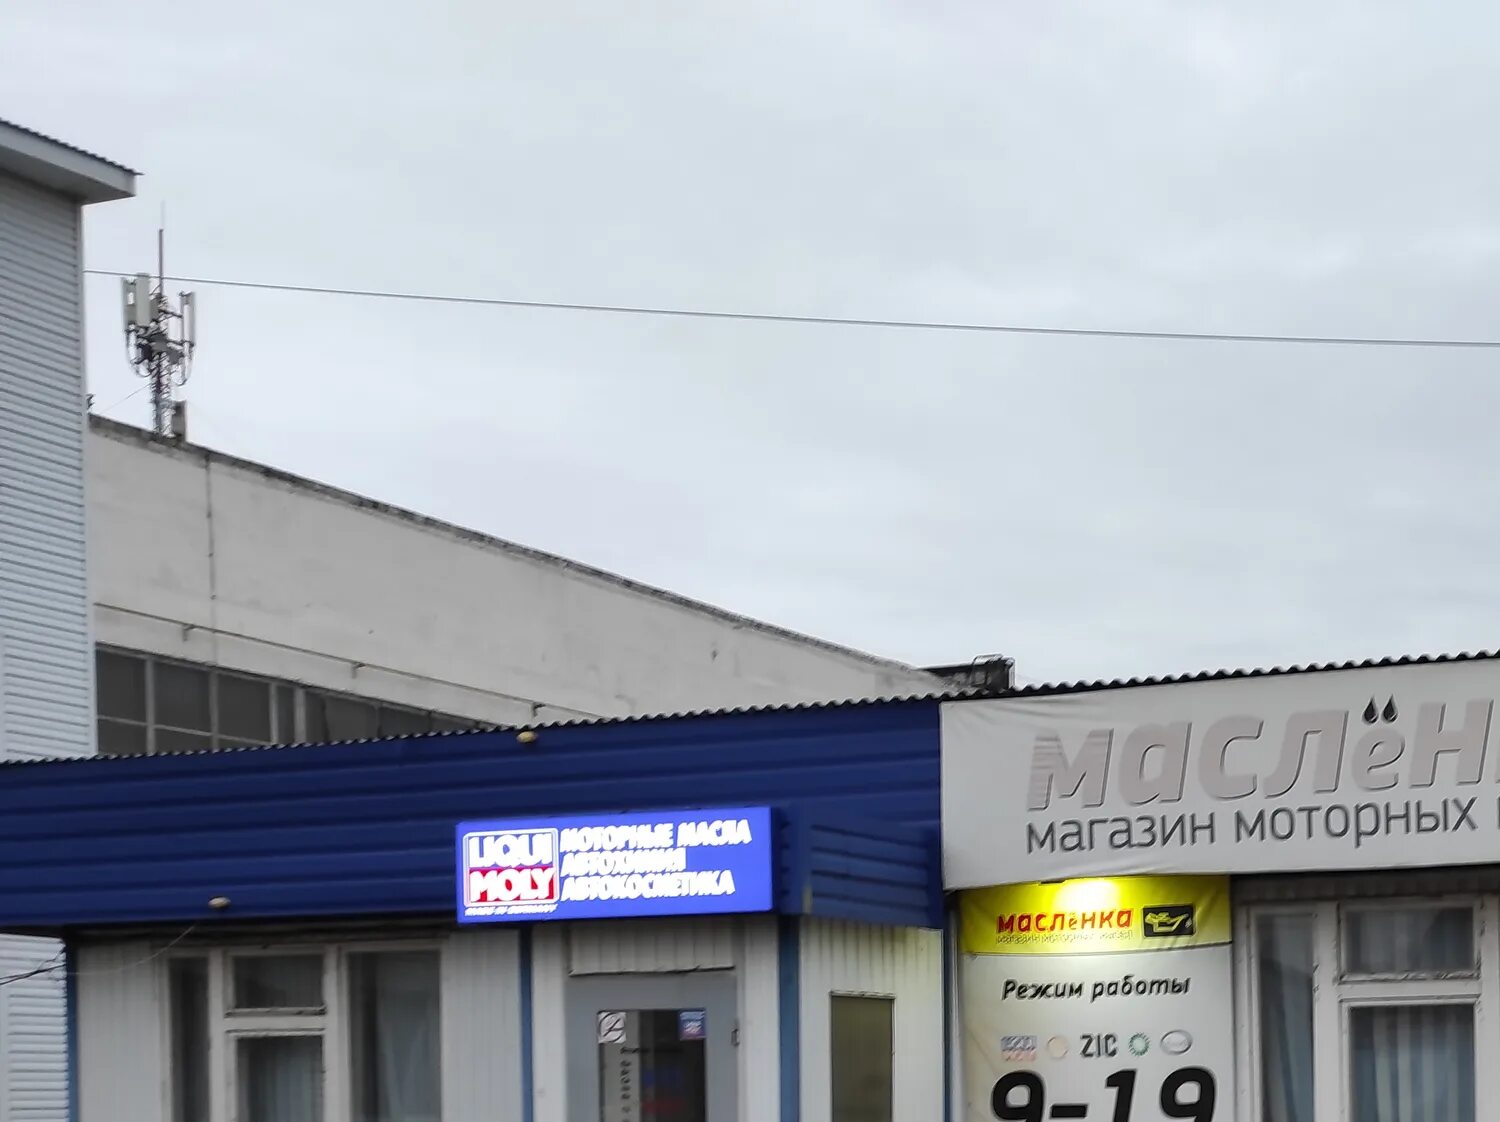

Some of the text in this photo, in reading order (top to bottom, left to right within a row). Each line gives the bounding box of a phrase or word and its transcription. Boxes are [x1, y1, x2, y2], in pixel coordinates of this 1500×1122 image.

[1025, 814, 1217, 855] магазин
[1233, 796, 1479, 848] моторных
[468, 832, 553, 868] LIQUI
[469, 867, 555, 902] MOLY
[1002, 975, 1191, 1003] Режим работы
[1080, 1033, 1118, 1057] ZIC
